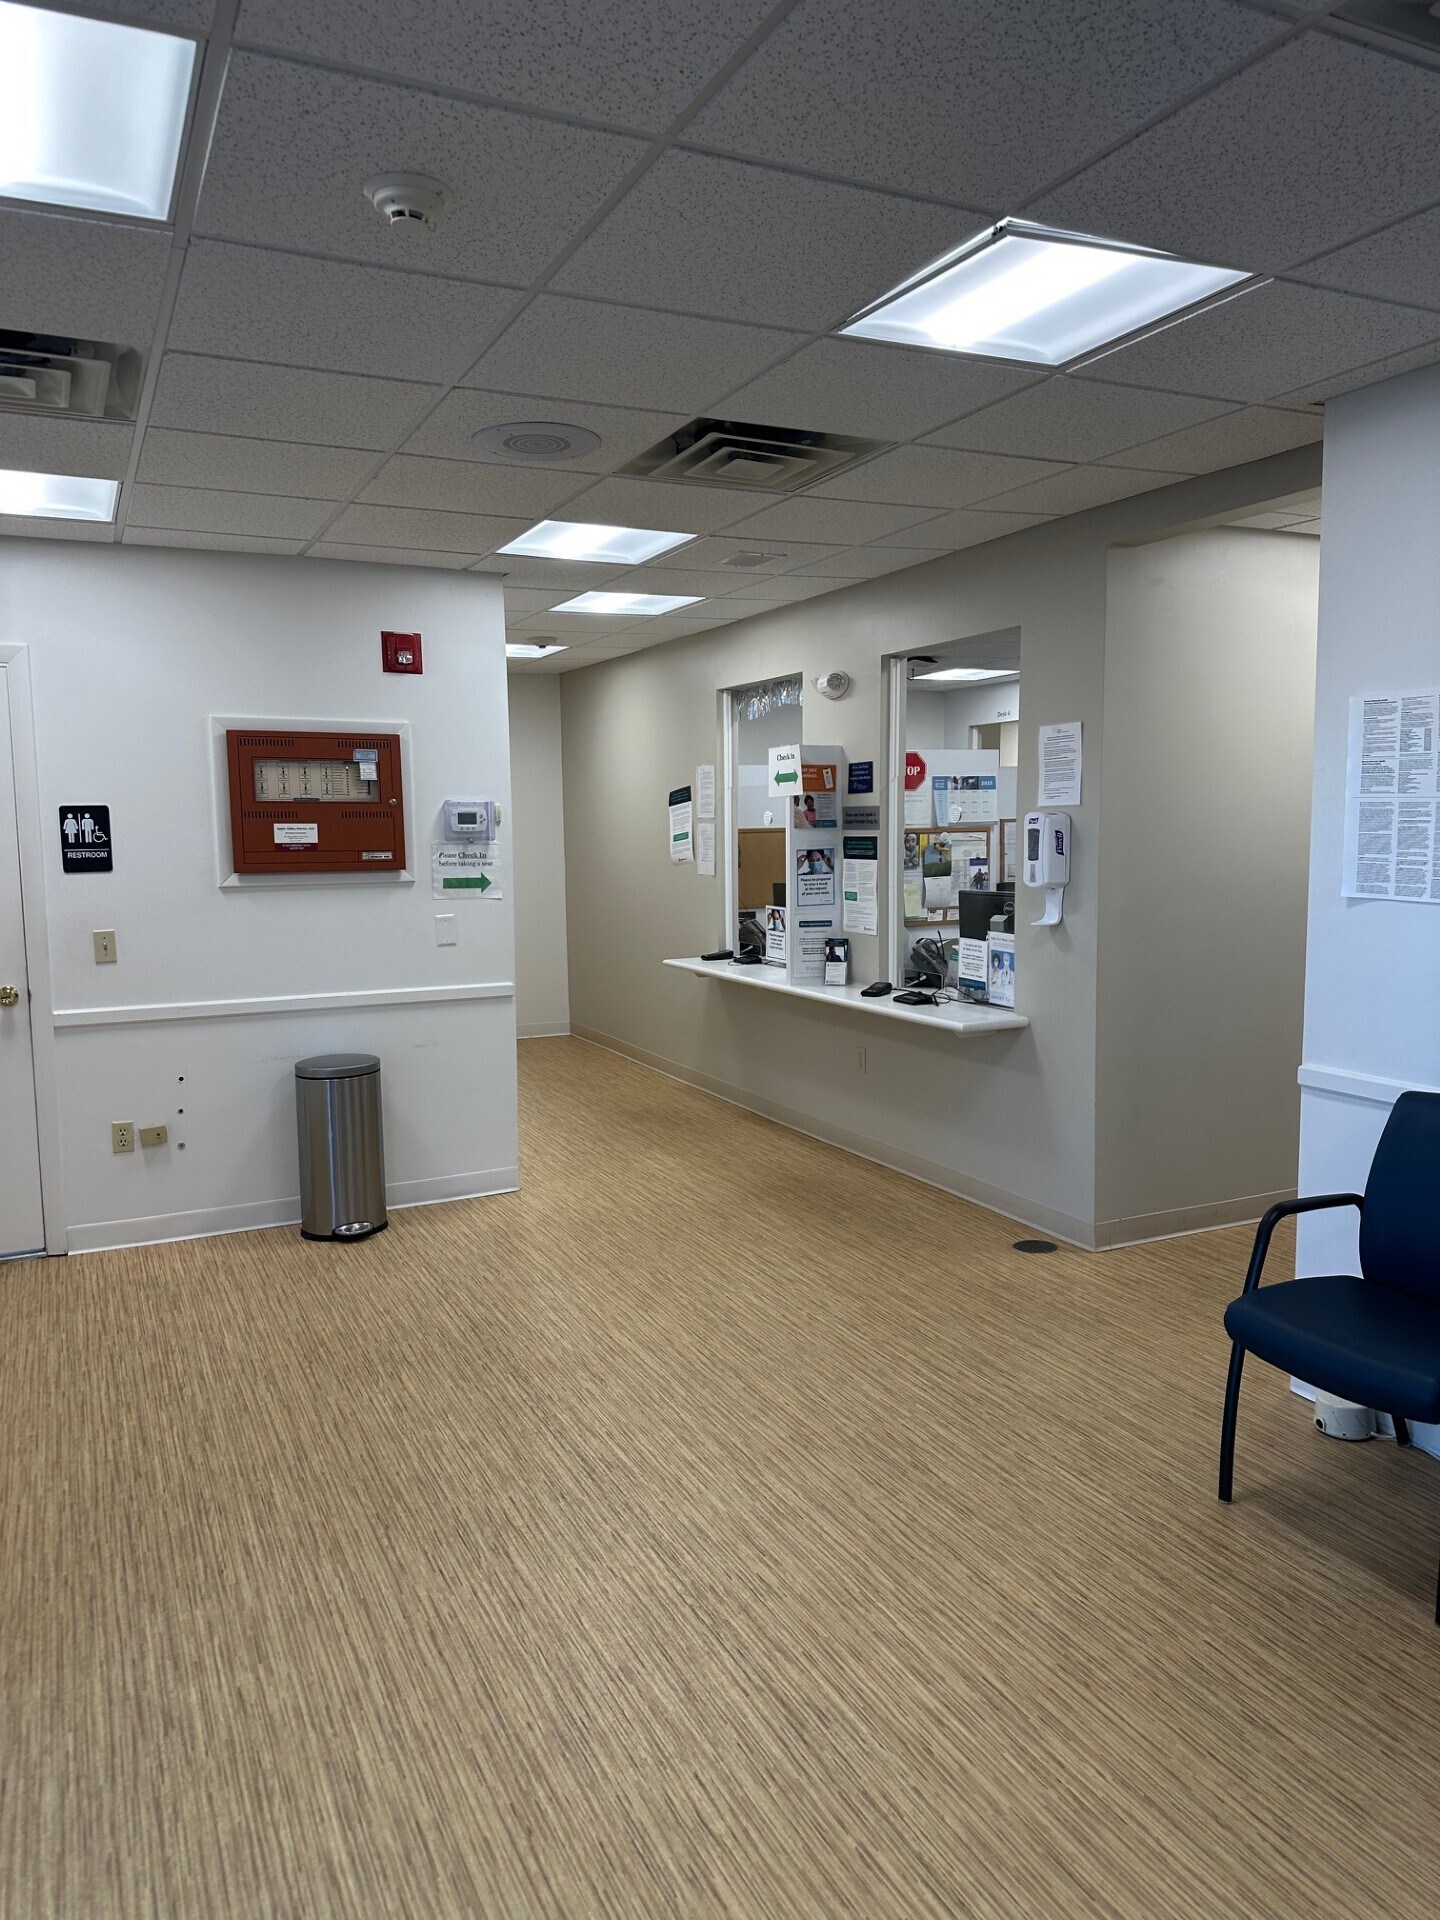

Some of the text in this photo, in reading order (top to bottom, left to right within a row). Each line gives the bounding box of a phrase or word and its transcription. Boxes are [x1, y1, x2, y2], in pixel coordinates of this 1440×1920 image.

[776, 753, 790, 762] Check
[67, 851, 108, 859] RESTROOM
[438, 851, 487, 859] Please Check In
[458, 860, 476, 868] taking
